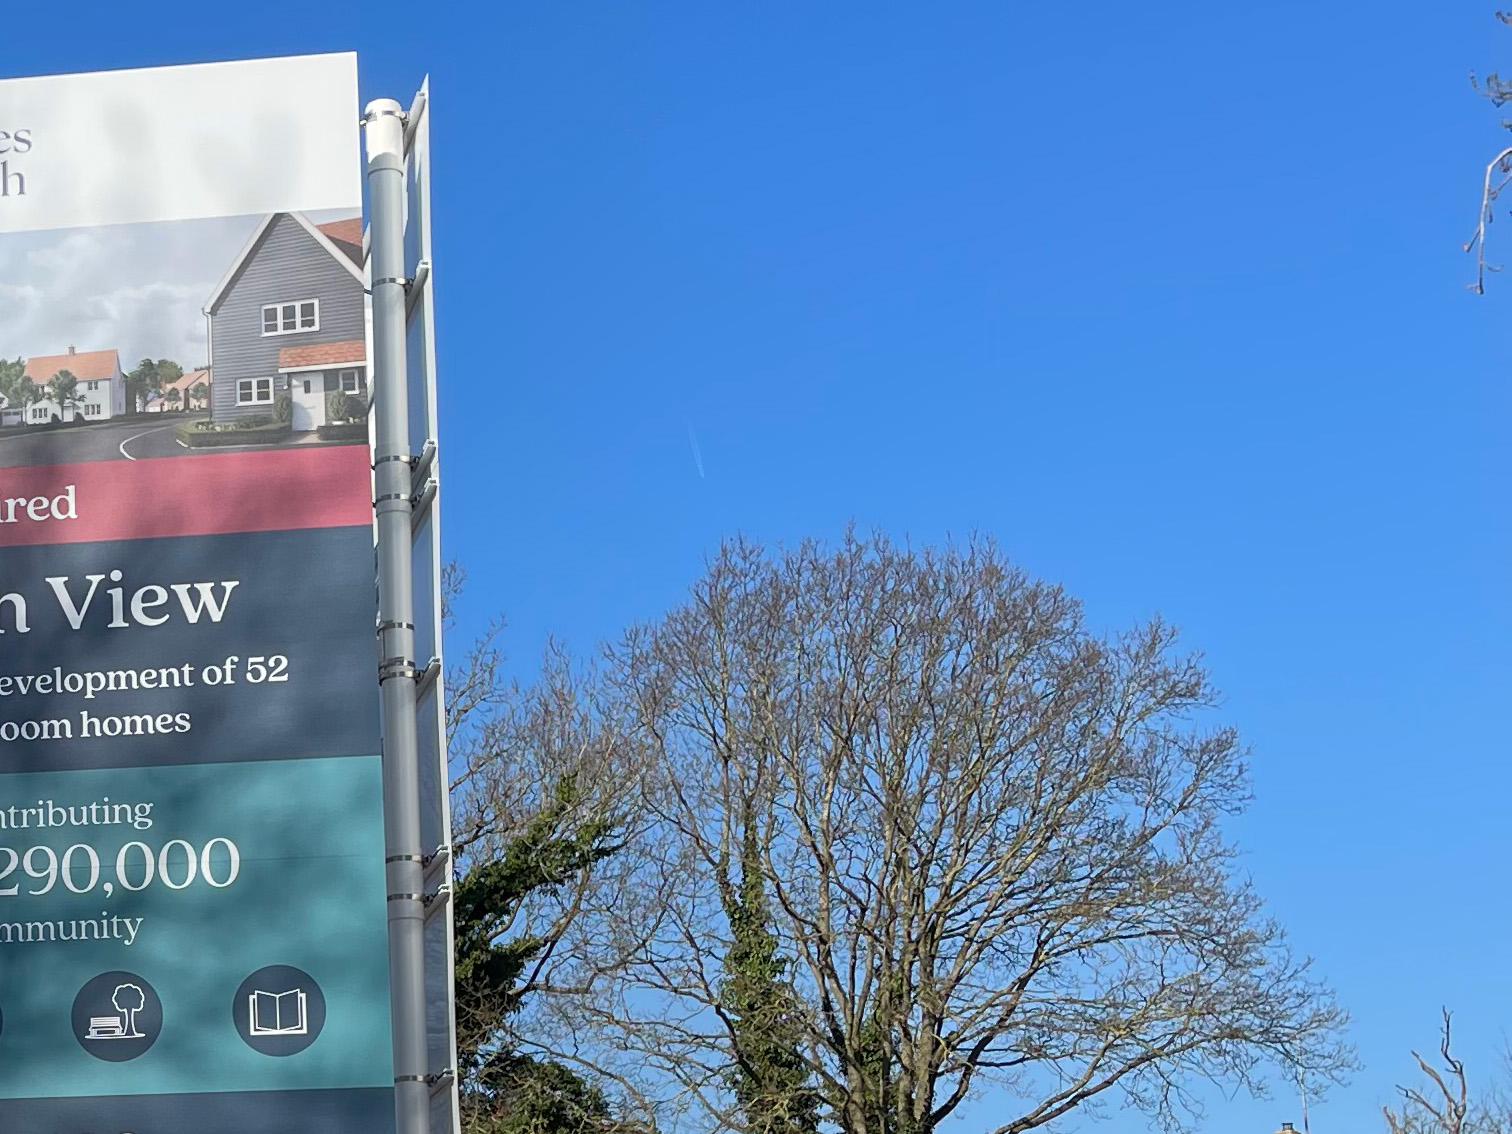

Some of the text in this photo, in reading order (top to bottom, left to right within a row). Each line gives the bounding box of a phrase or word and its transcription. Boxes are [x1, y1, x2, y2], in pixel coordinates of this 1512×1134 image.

[45, 569, 240, 630] View
[201, 657, 238, 685] of
[245, 655, 289, 682] 52
[80, 707, 191, 737] homes
